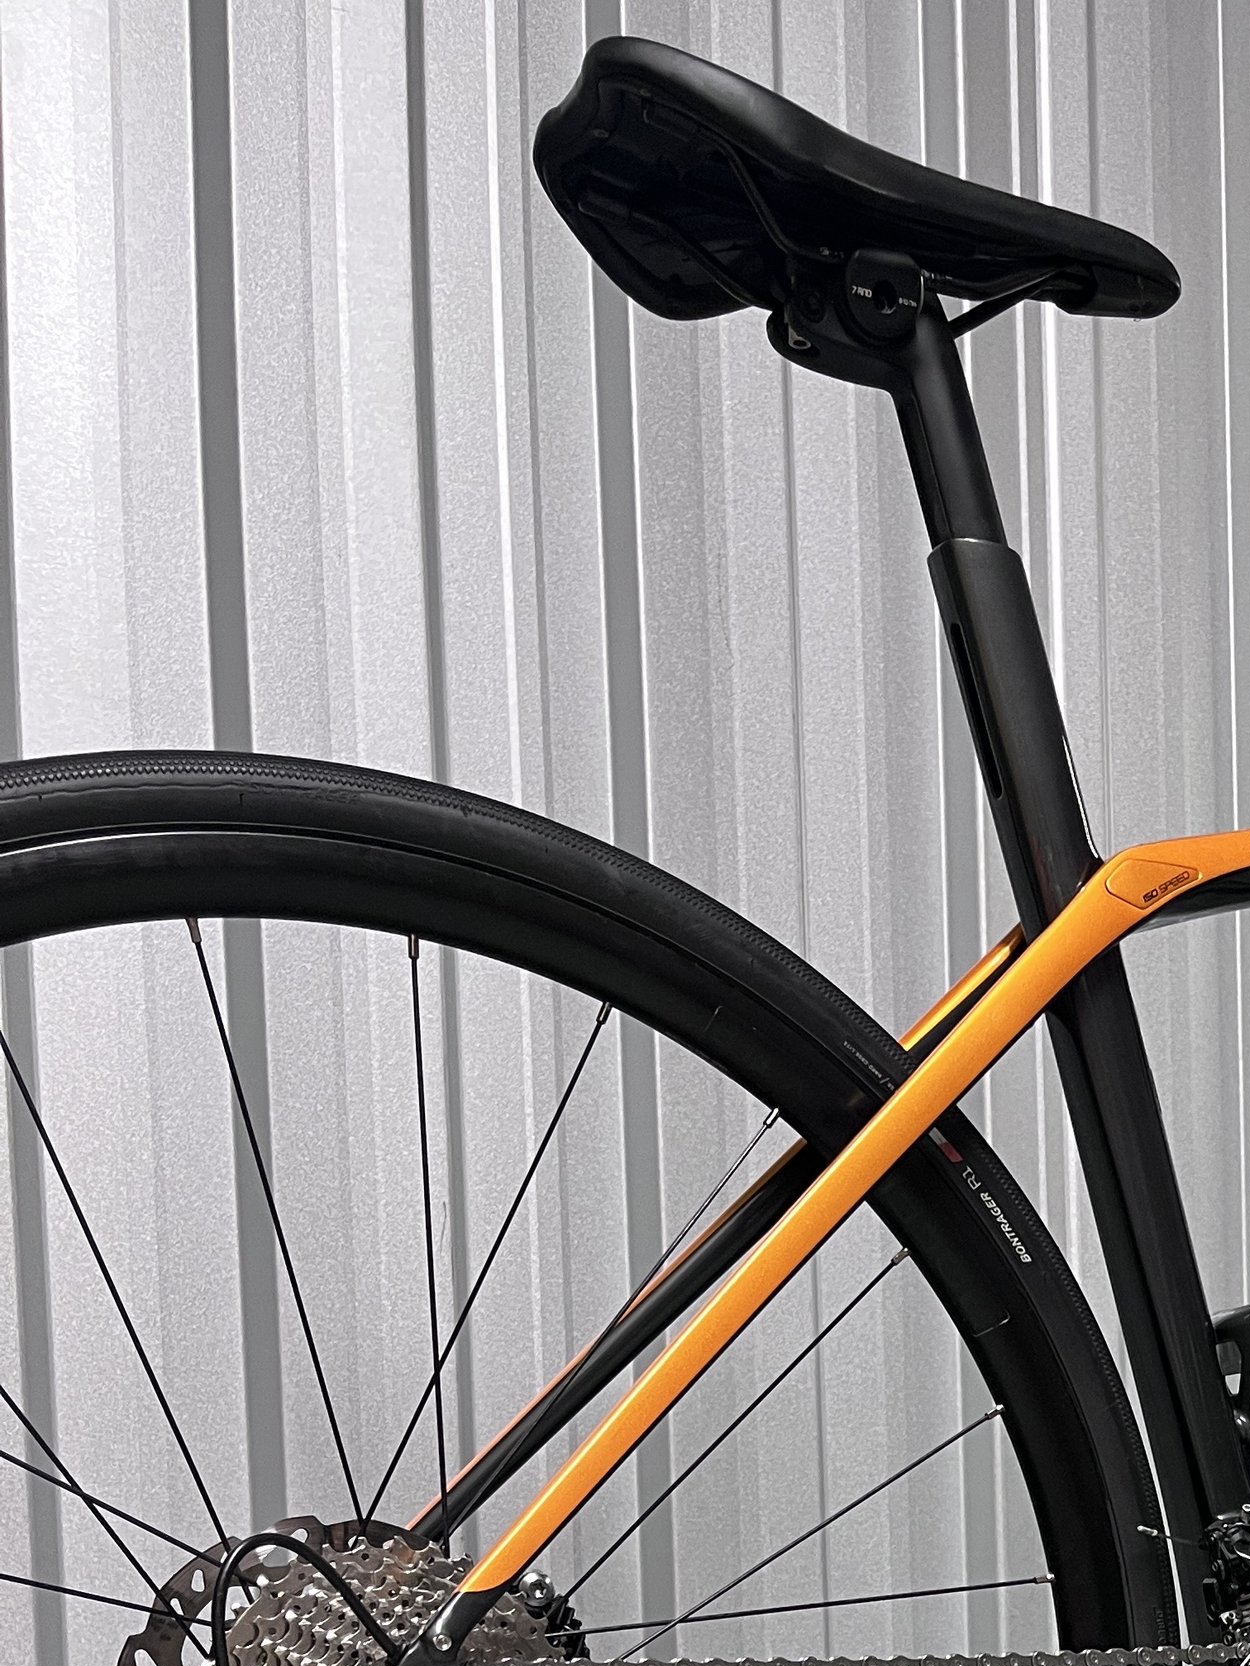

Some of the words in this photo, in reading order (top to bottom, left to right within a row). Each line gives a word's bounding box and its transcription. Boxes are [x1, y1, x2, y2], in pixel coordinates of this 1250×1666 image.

[1142, 888, 1159, 903] ISO
[1158, 870, 1190, 894] SPEED
[962, 1166, 982, 1190] R1
[980, 1192, 1032, 1263] BONTRAGER
